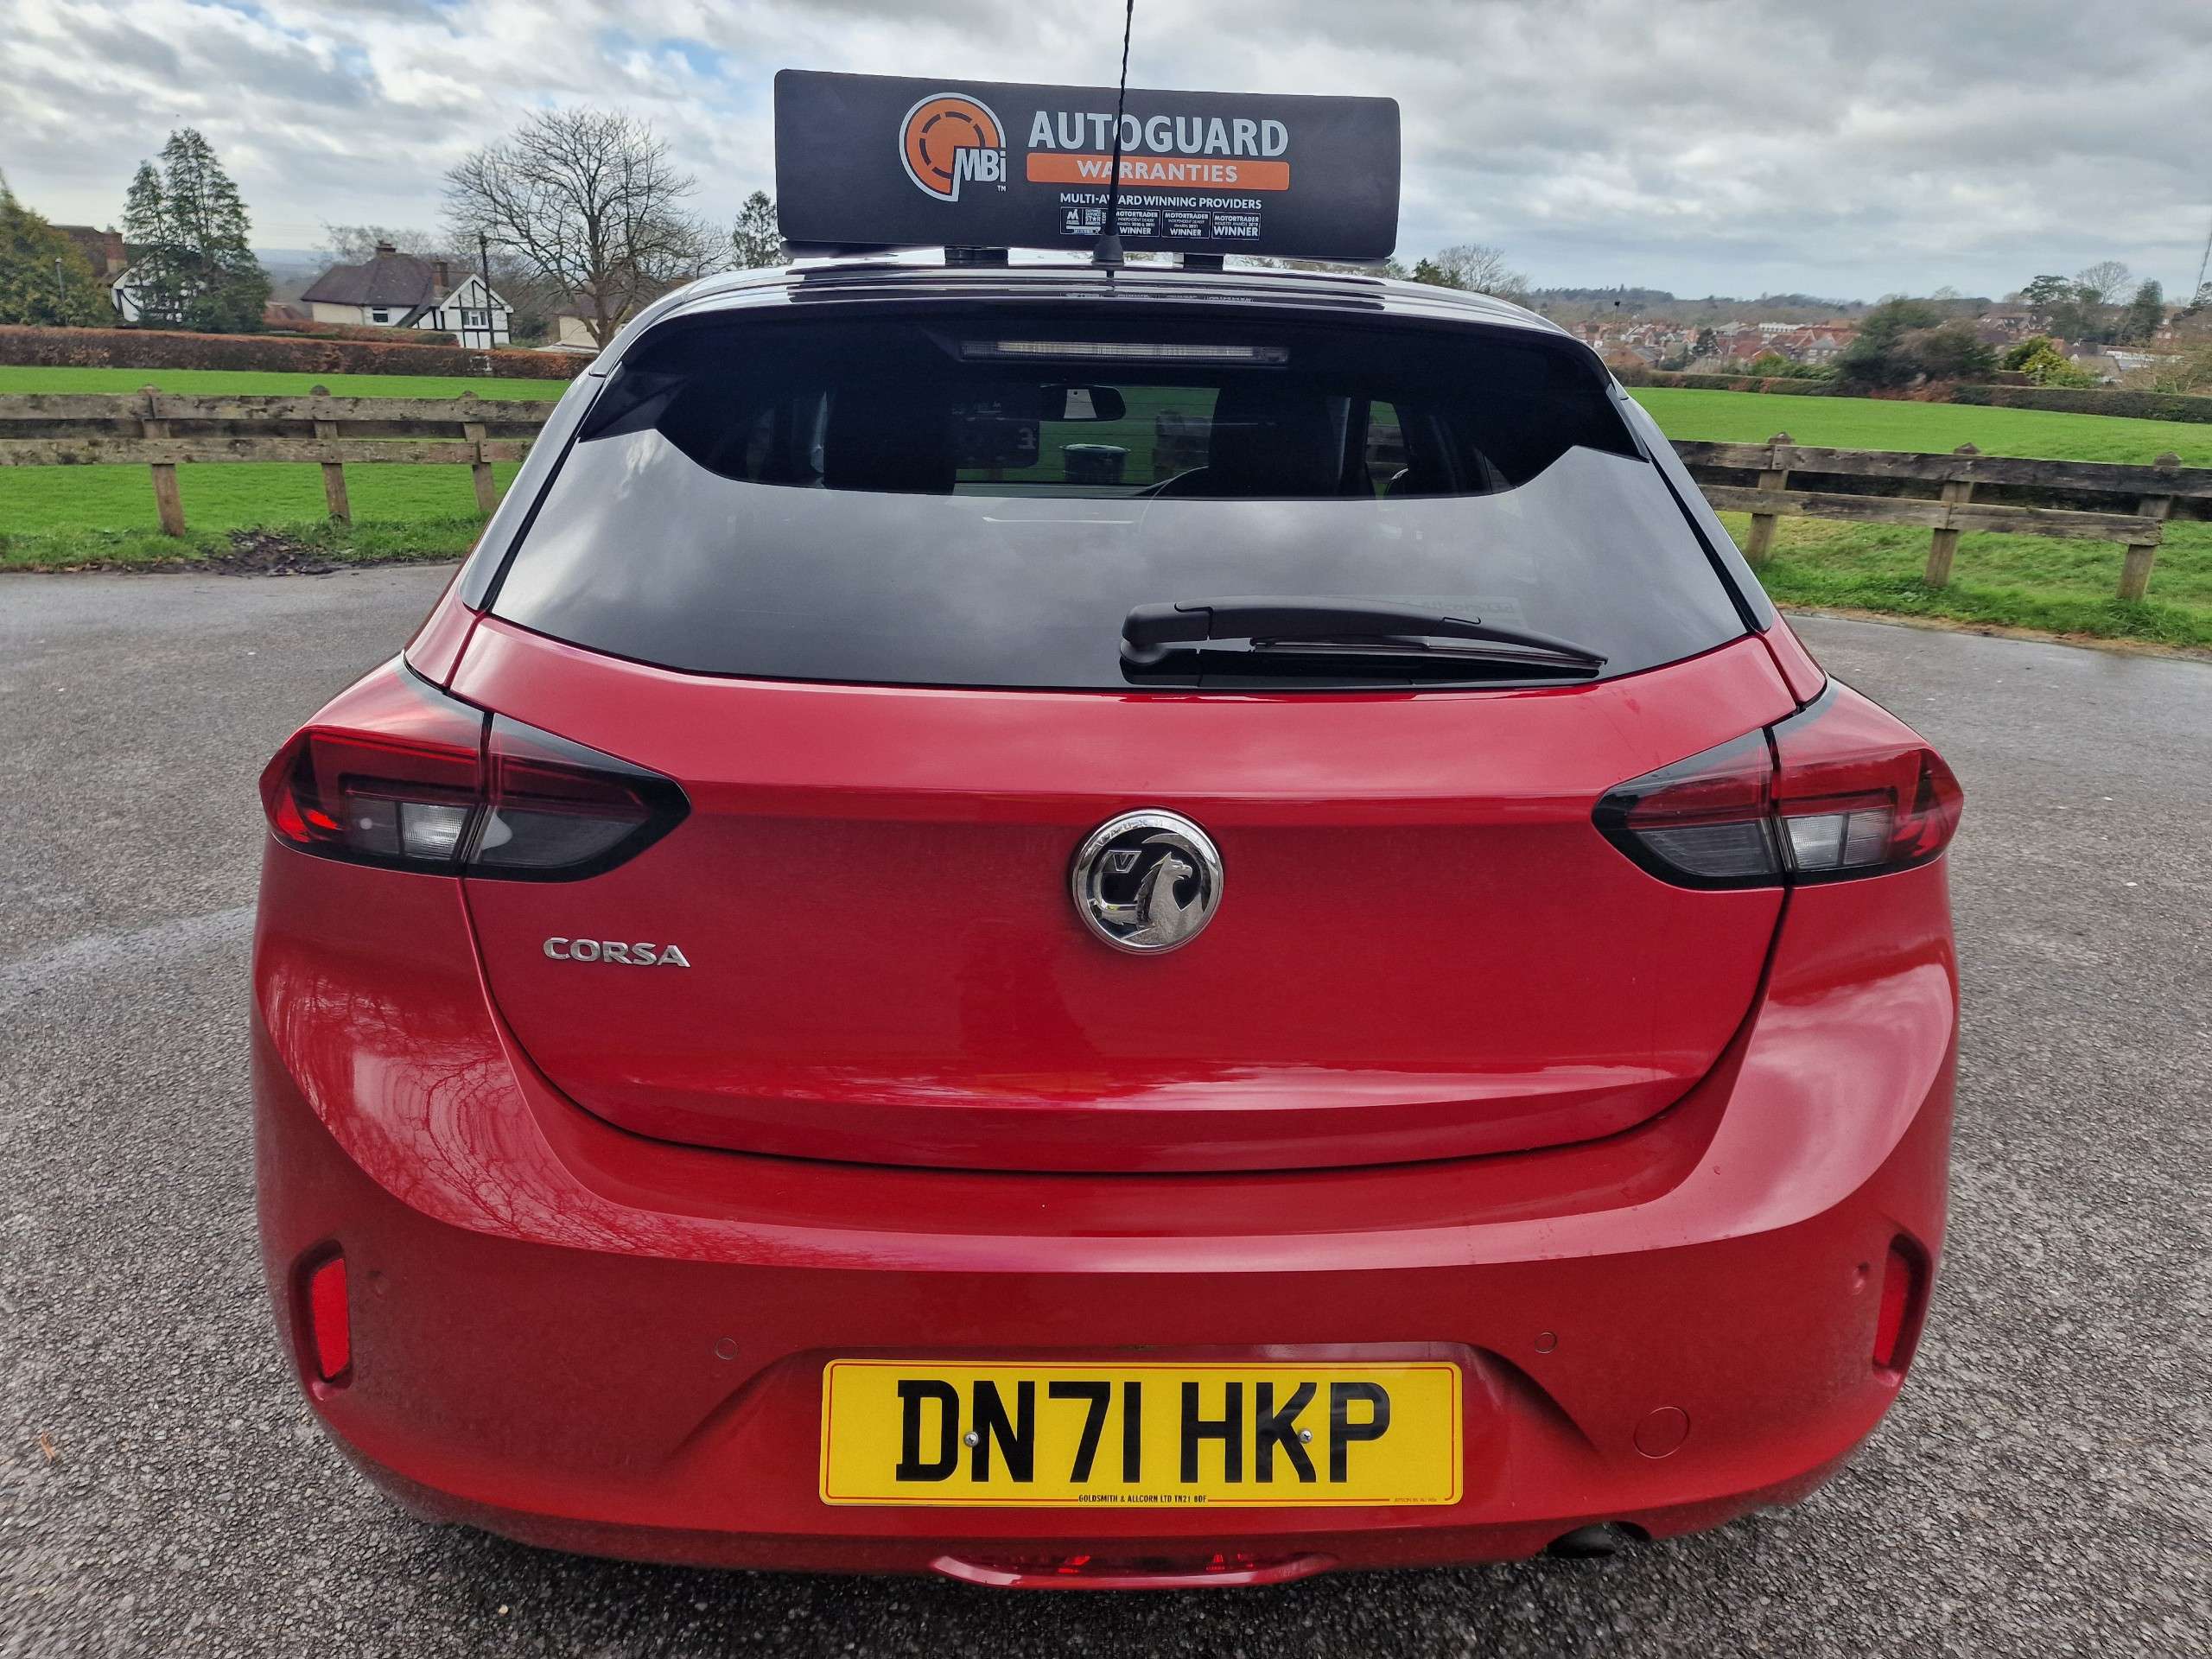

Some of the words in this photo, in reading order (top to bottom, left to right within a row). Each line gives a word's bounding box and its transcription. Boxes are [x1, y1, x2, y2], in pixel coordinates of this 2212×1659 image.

[1027, 111, 1289, 157] AUTOGUARD
[1077, 160, 1238, 182] WARRANTIES
[1143, 195, 1197, 207] WINNING
[1199, 197, 1262, 209] PROVIDERS
[1119, 226, 1152, 235] WINNER
[1214, 226, 1259, 236] WINNER
[543, 937, 691, 968] CORSA
[895, 1379, 1141, 1484] DN71
[1180, 1381, 1391, 1484] HKP
[1078, 1494, 1118, 1503] GOLDSMITH
[1128, 1494, 1158, 1503] ALLCORN
